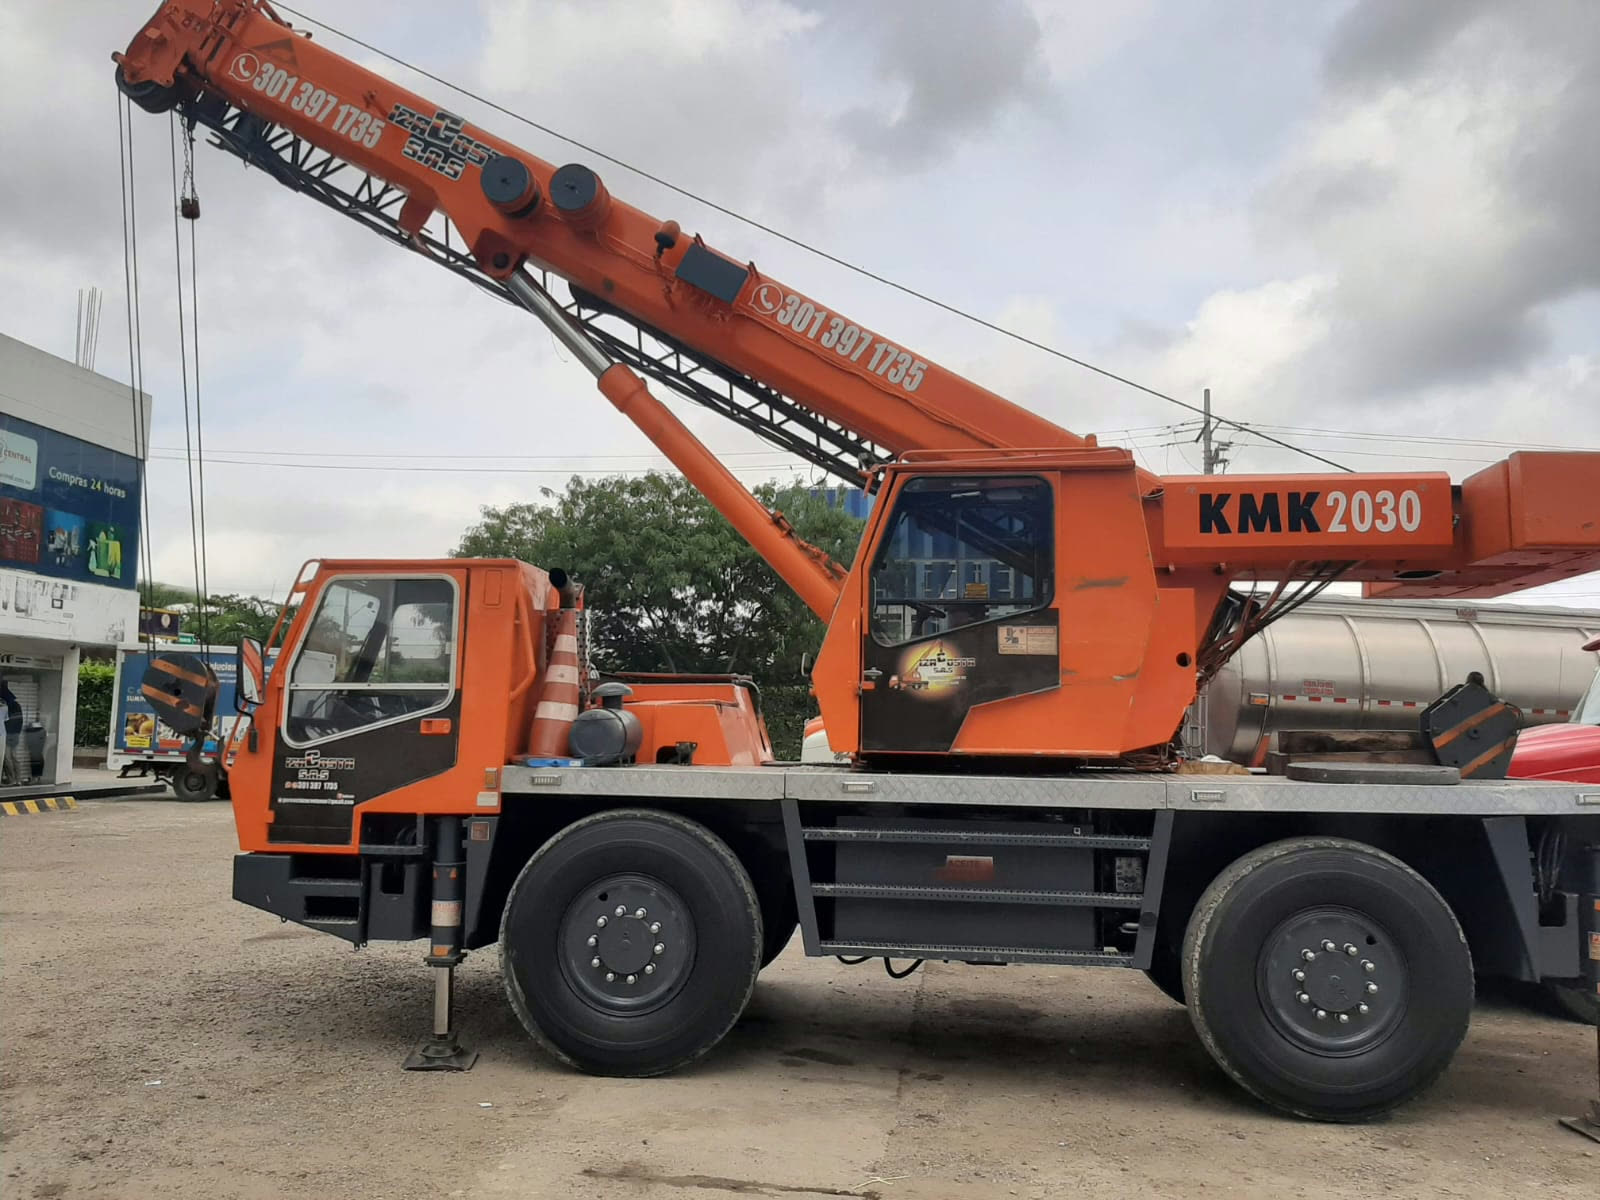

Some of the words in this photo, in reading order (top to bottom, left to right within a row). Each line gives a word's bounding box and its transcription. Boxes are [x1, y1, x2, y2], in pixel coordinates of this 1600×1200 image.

[252, 62, 299, 103] 301
[290, 82, 339, 123] 397
[331, 104, 386, 149] 1735
[776, 294, 828, 340] 301
[820, 317, 873, 363] 397
[866, 342, 928, 392] 1735
[3, 448, 32, 464] CENTRAL
[48, 466, 88, 487] Compras
[90, 478, 101, 491] 24
[103, 482, 126, 498] horas
[1199, 491, 1322, 534] KMK
[1326, 490, 1422, 533] 2030
